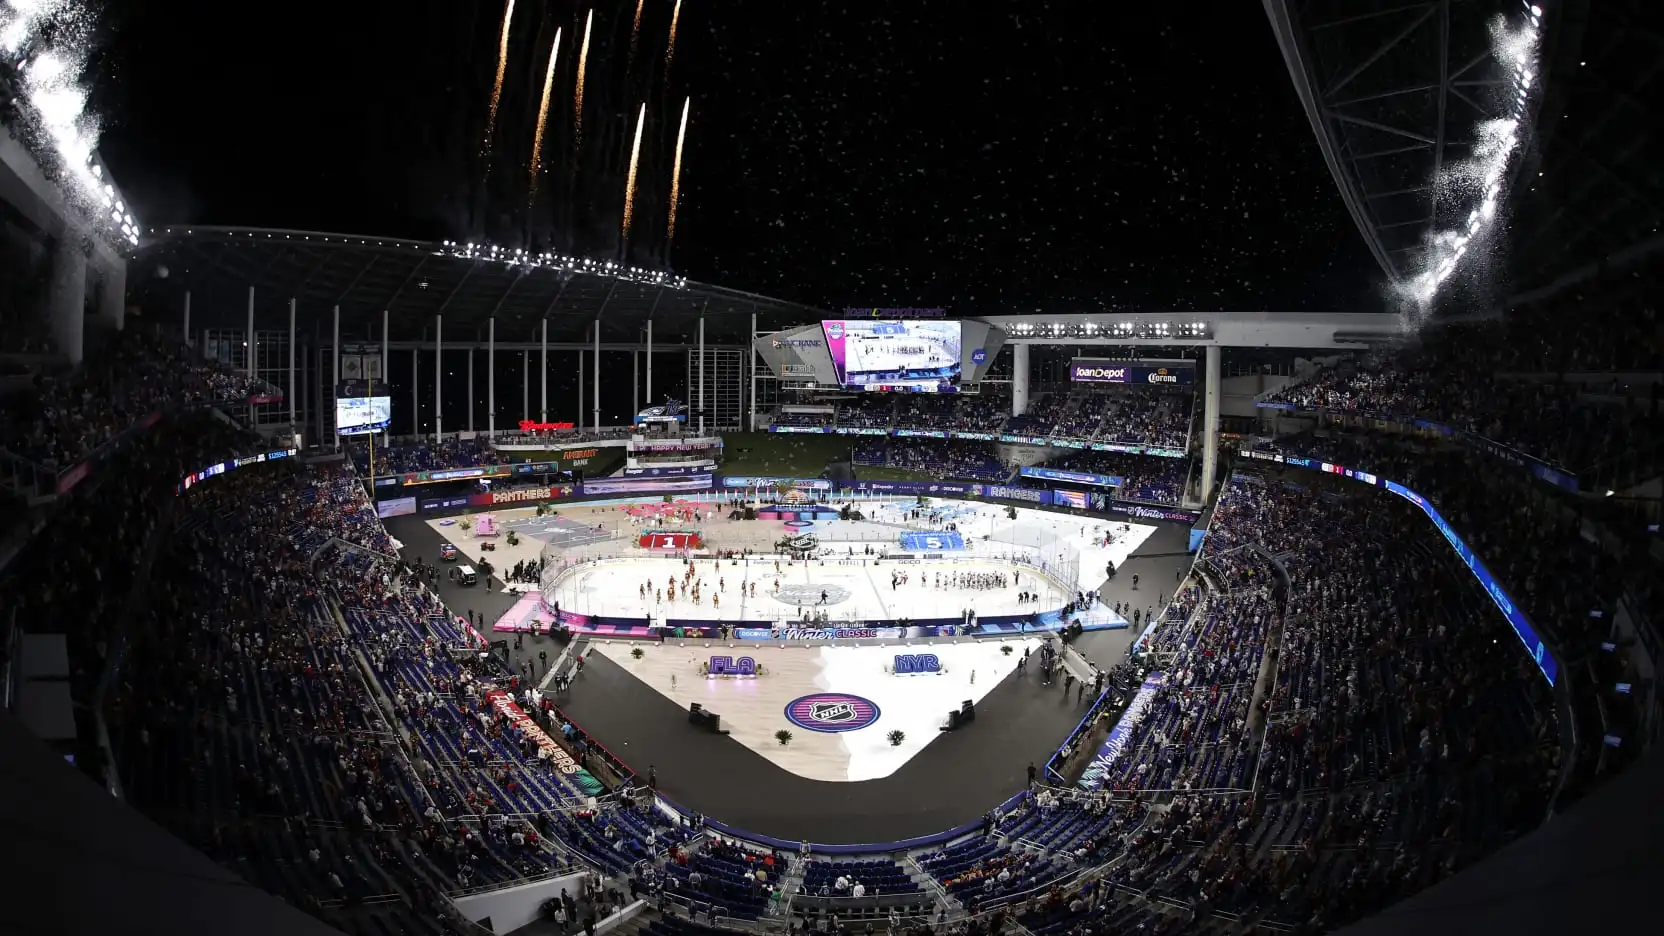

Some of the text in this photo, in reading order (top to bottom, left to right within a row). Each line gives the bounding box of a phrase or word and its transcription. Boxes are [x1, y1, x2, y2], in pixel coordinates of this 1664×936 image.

[1076, 367, 1124, 379] loanDepot
[1148, 373, 1176, 384] Corona
[573, 459, 588, 467] BANK
[491, 487, 551, 504] PANTHERS
[991, 486, 1041, 502] RANGERS
[1134, 506, 1164, 519] Winter
[1164, 512, 1188, 520] CLASSIC
[662, 537, 676, 548] 1
[926, 537, 942, 549] 5
[782, 627, 877, 640] Winter CLASSIC
[710, 656, 755, 674] FLA
[895, 654, 940, 673] NYR
[820, 705, 847, 719] NHL
[1105, 727, 1132, 757] York
[1096, 748, 1119, 770] New
